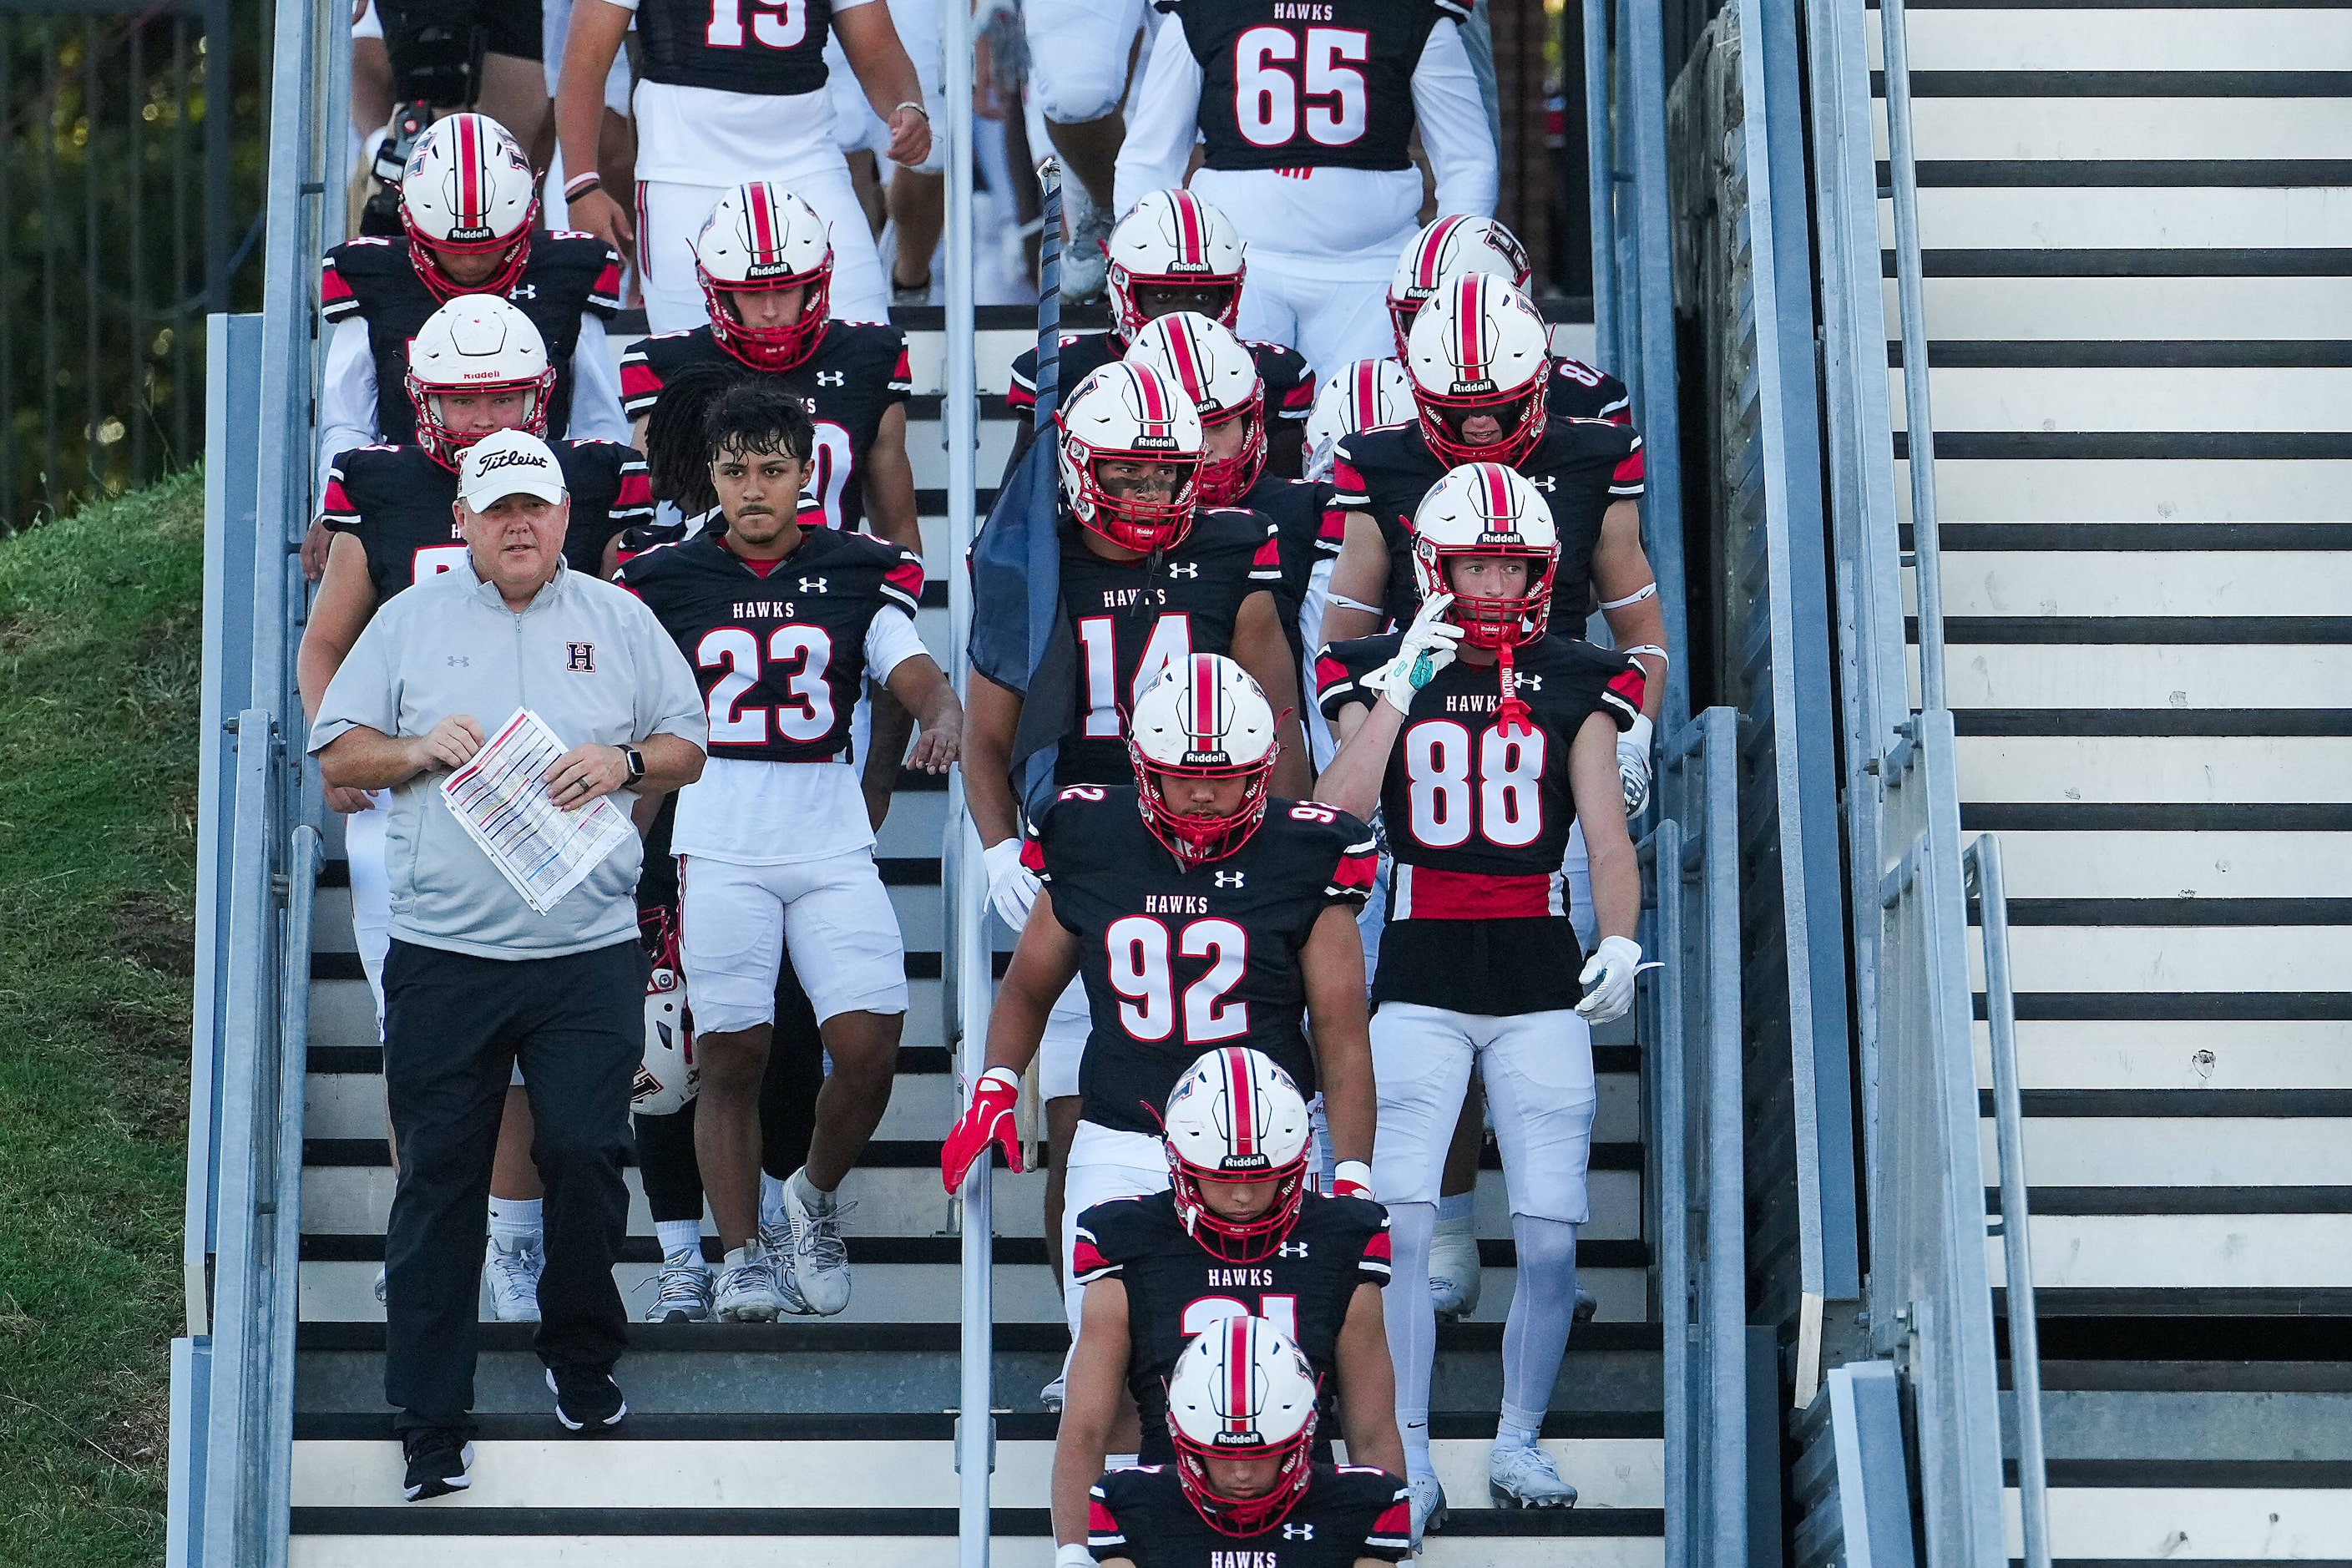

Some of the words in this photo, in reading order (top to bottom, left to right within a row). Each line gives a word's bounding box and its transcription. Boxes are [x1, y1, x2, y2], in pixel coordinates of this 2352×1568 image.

[1273, 3, 1333, 21] HAWKS
[1235, 25, 1370, 148] 65
[452, 230, 490, 240] Riddell
[750, 263, 788, 276] Riddell
[1172, 261, 1209, 271] Riddell
[463, 370, 500, 379] Riddell
[1453, 381, 1492, 392] Riddell
[1138, 438, 1175, 448] Riddell
[475, 449, 548, 478] Titleist
[1482, 534, 1521, 544] Riddell
[1103, 589, 1166, 608] HAWS
[732, 601, 795, 619] HAWKS
[566, 641, 596, 673] H
[696, 623, 836, 746] 23
[1502, 667, 1515, 698] NXTRND
[1446, 695, 1504, 712] HAWK
[1186, 753, 1227, 762] Riddell
[1404, 718, 1548, 849] 88
[1146, 894, 1208, 914] HAWKS
[1105, 914, 1251, 1045] 92
[1225, 1156, 1265, 1167] Riddell
[1208, 1269, 1273, 1287] HAWKS
[1217, 1434, 1260, 1444] Riddell
[1211, 1551, 1277, 1568] HAWKS
